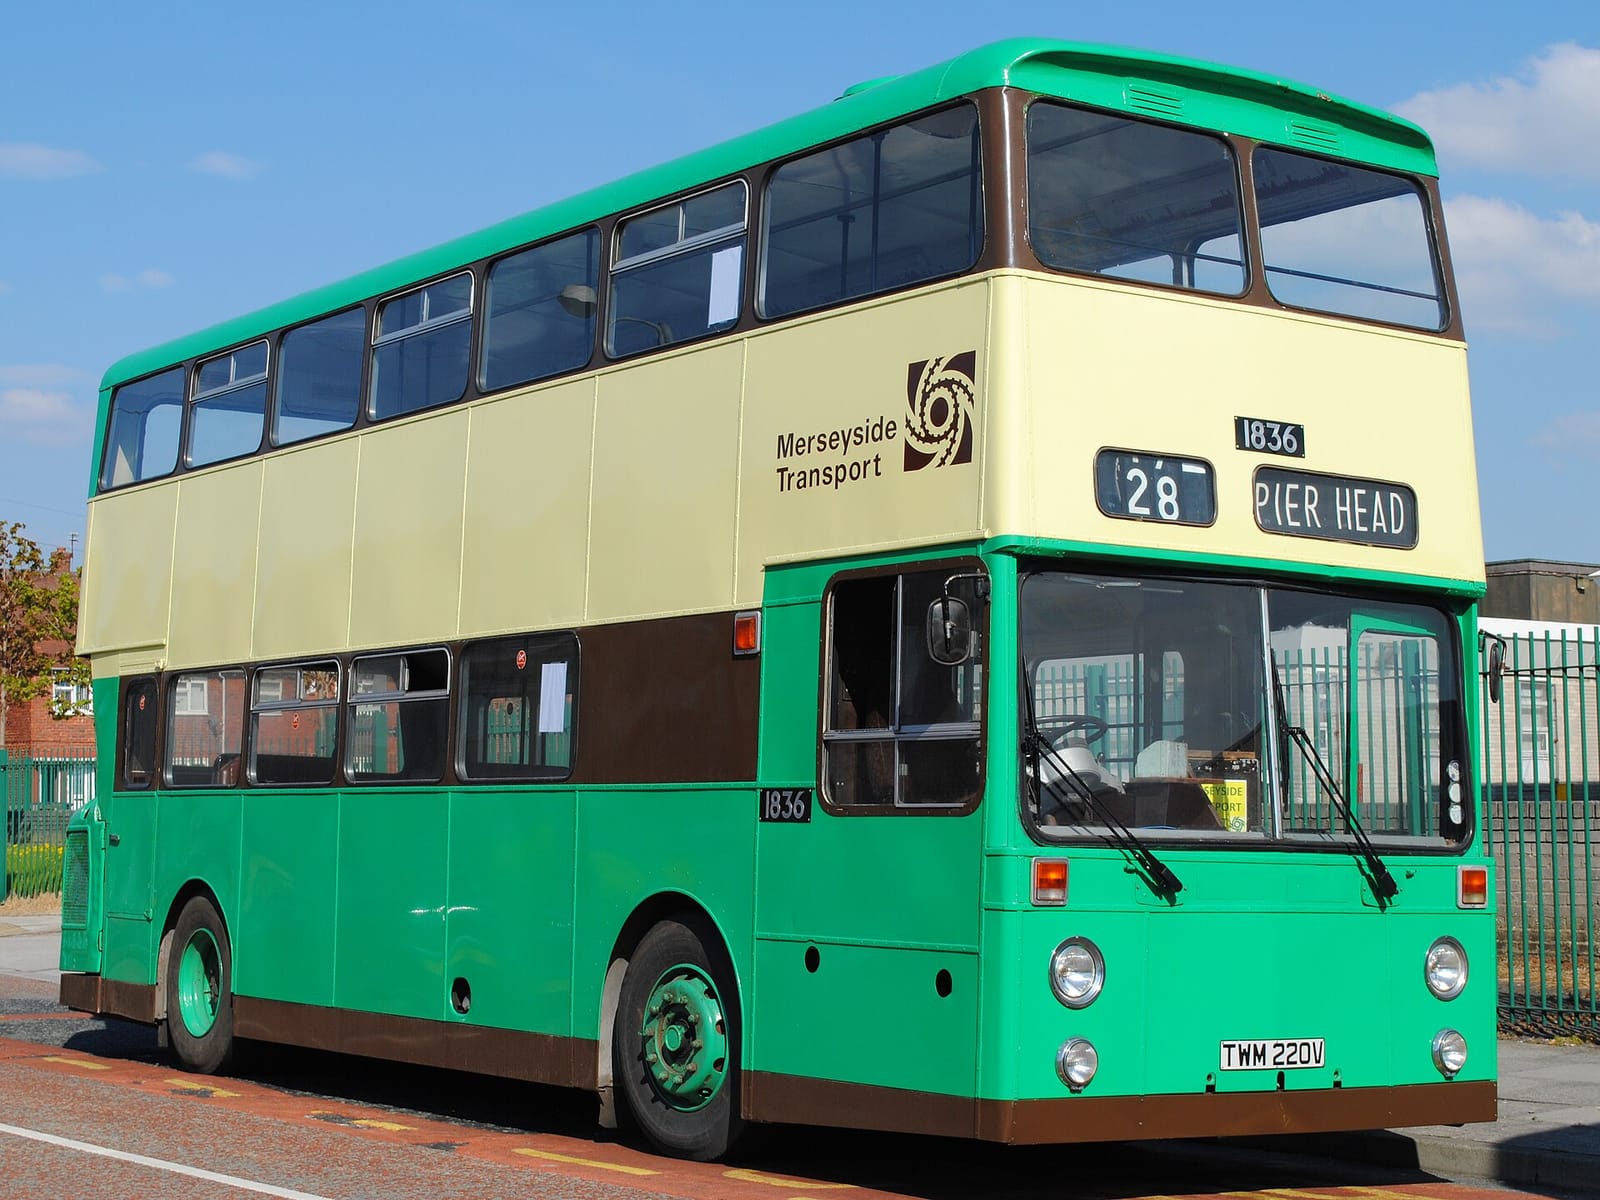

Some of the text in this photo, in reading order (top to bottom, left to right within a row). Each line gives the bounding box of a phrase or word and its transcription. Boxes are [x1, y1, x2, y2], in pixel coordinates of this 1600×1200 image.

[776, 415, 897, 459] Merseyside
[1243, 419, 1298, 454] 1836
[776, 453, 882, 492] Transport
[1126, 467, 1180, 521] 28
[1255, 482, 1405, 535] PIER HEAD
[765, 790, 805, 819] 1836
[1222, 1041, 1323, 1067] TWM 220V
